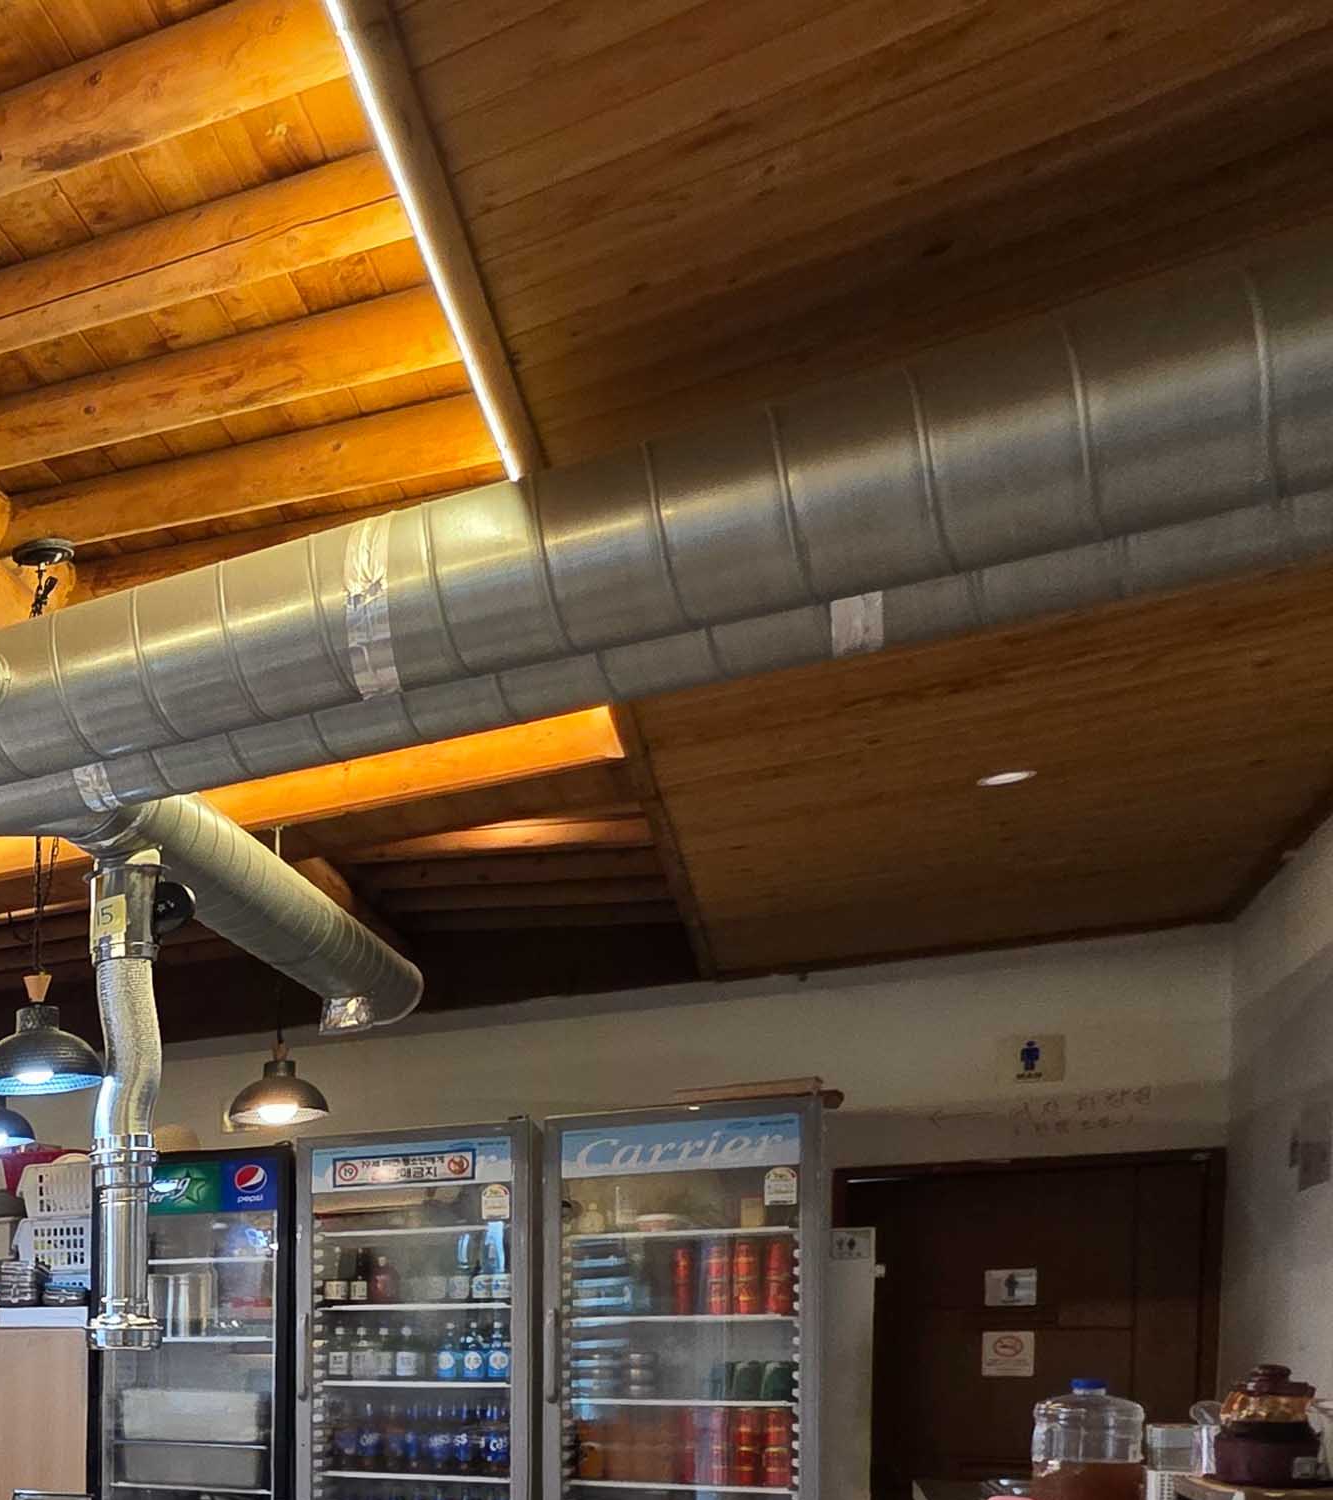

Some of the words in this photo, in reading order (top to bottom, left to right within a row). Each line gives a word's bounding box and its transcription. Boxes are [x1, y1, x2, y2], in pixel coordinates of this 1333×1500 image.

[96, 904, 114, 927] 15
[575, 1129, 784, 1171] Carrier
[236, 1194, 264, 1205] pepsi
